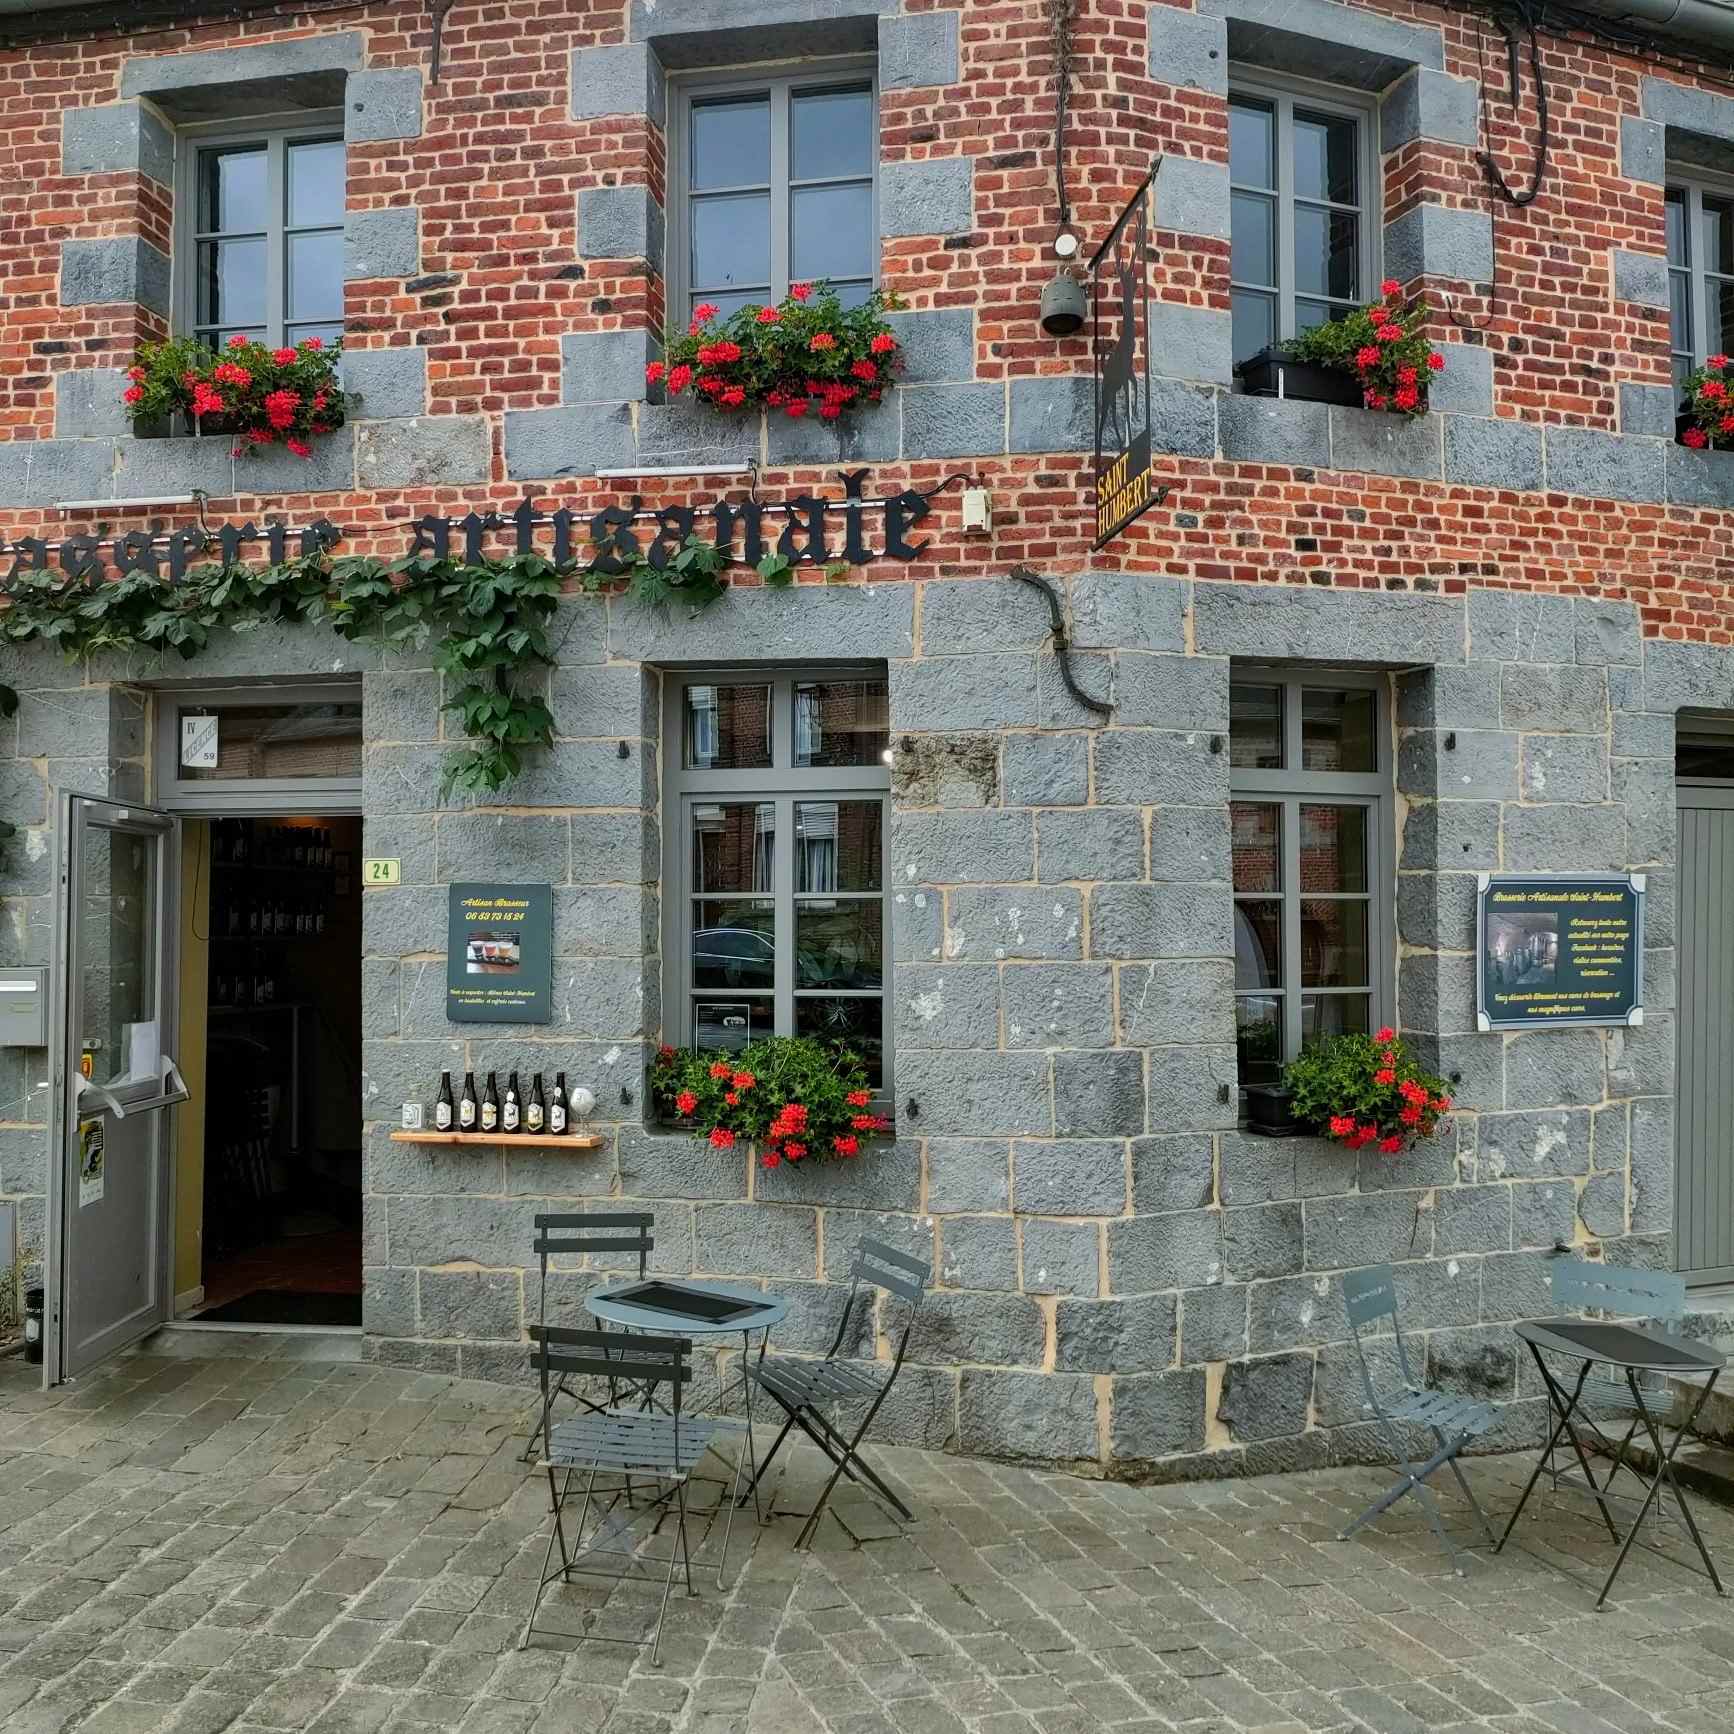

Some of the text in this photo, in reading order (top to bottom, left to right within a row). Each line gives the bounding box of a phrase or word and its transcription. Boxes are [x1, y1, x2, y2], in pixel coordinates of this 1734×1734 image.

[1098, 452, 1128, 505] SAINT
[1098, 467, 1151, 539] HUMBERT
[203, 752, 215, 761] 59
[374, 863, 389, 879] 24
